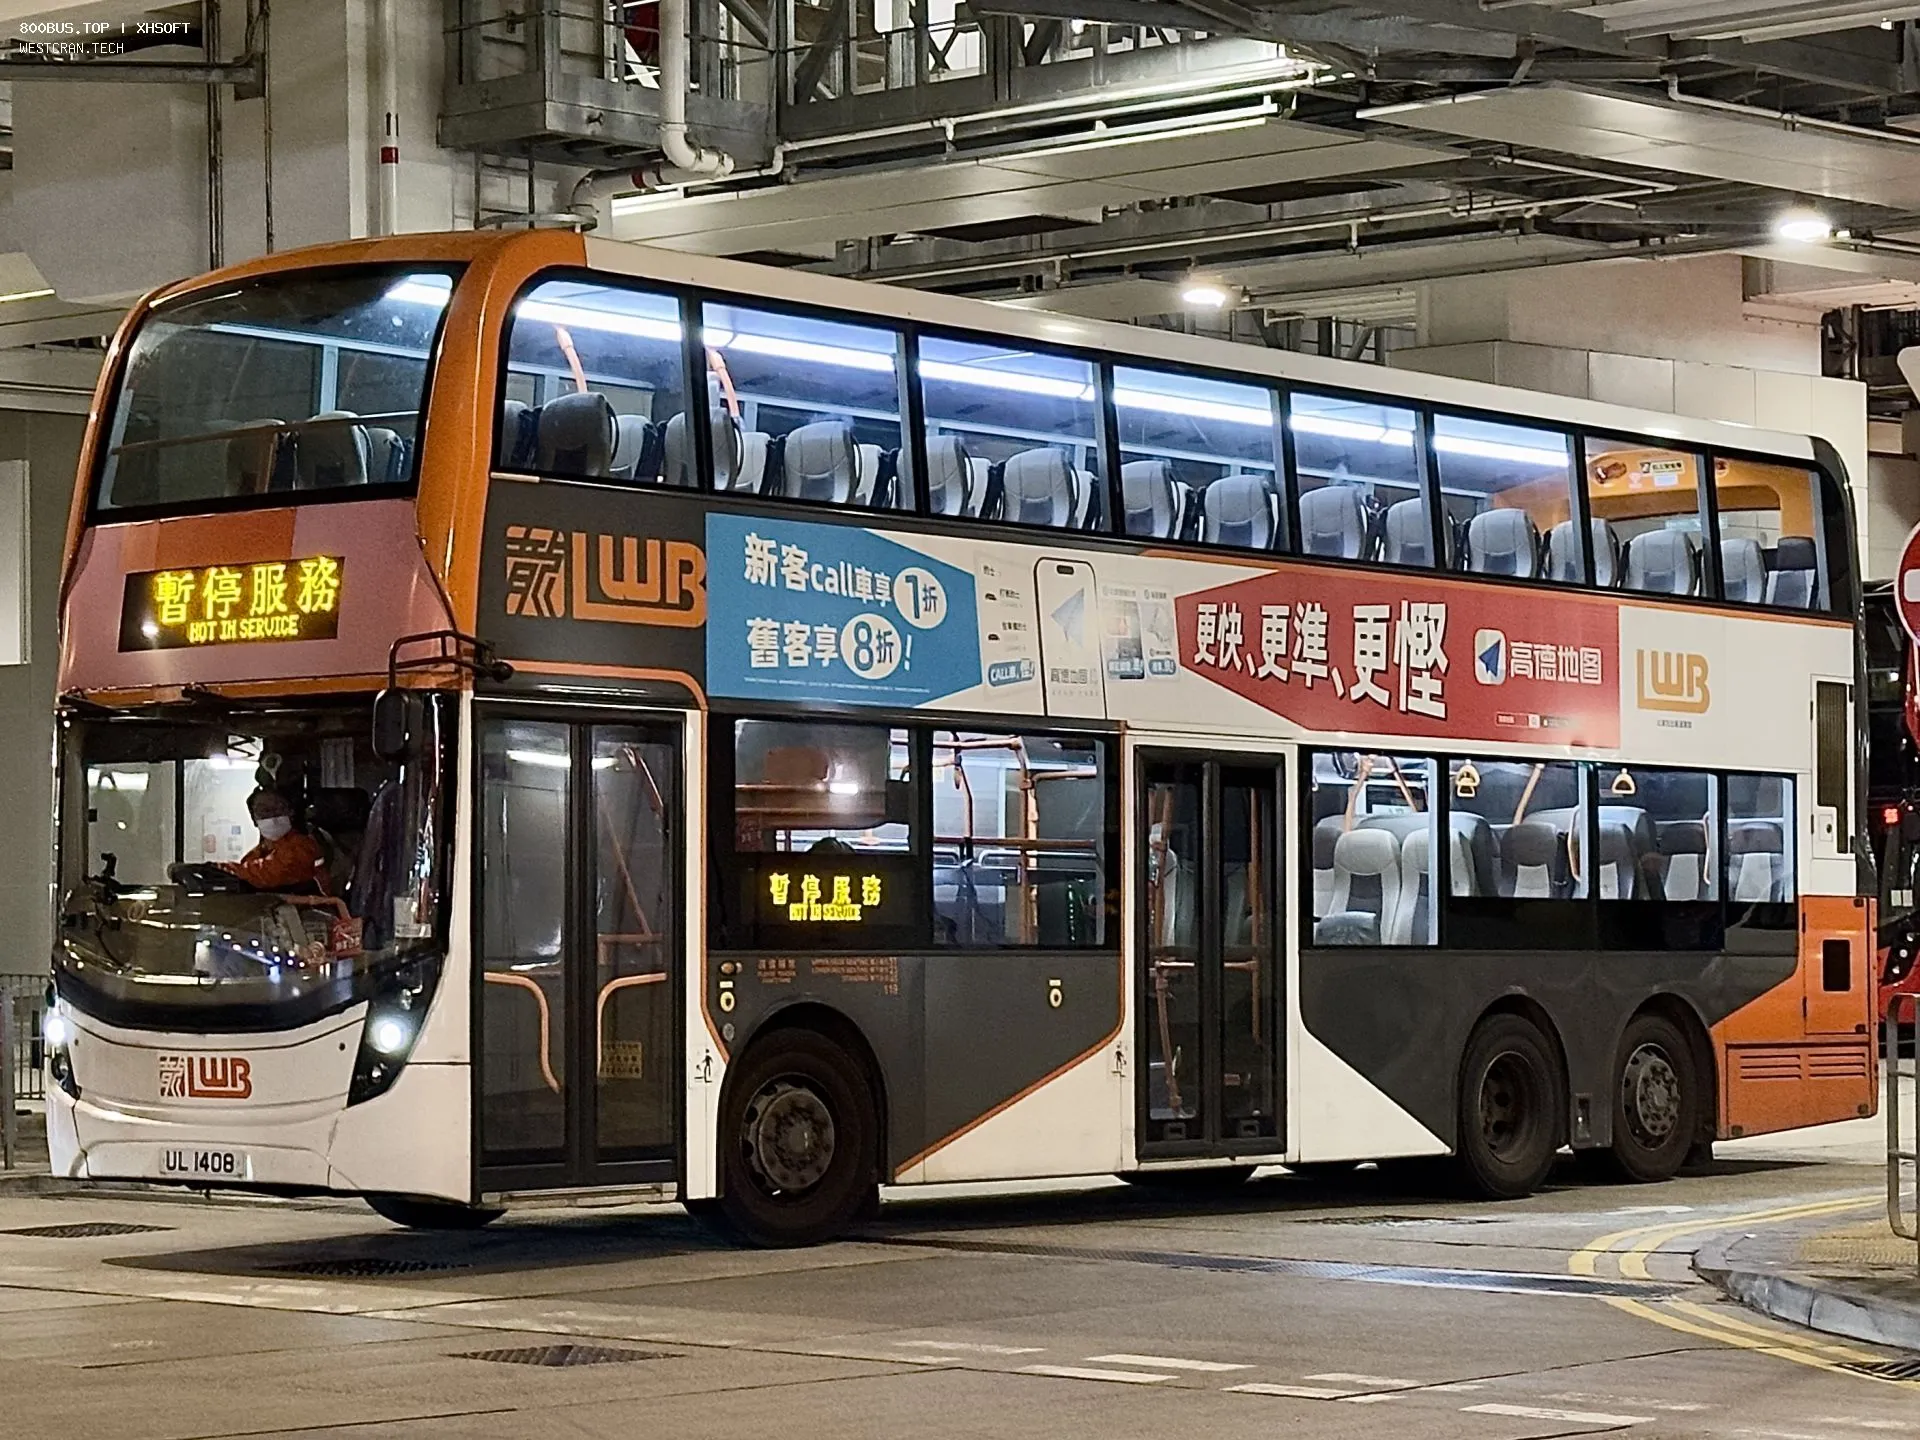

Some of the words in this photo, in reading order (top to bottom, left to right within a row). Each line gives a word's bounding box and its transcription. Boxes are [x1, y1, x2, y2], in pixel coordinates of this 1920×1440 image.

[155, 556, 340, 625] 暫停服務
[571, 531, 707, 628] LWB
[189, 620, 217, 643] NOT
[219, 619, 237, 640] IN
[239, 614, 299, 639] SERVICE
[1636, 648, 1710, 714] LWB
[187, 1056, 253, 1099] LWB
[165, 1150, 189, 1172] UL
[194, 1151, 235, 1174] 1408
